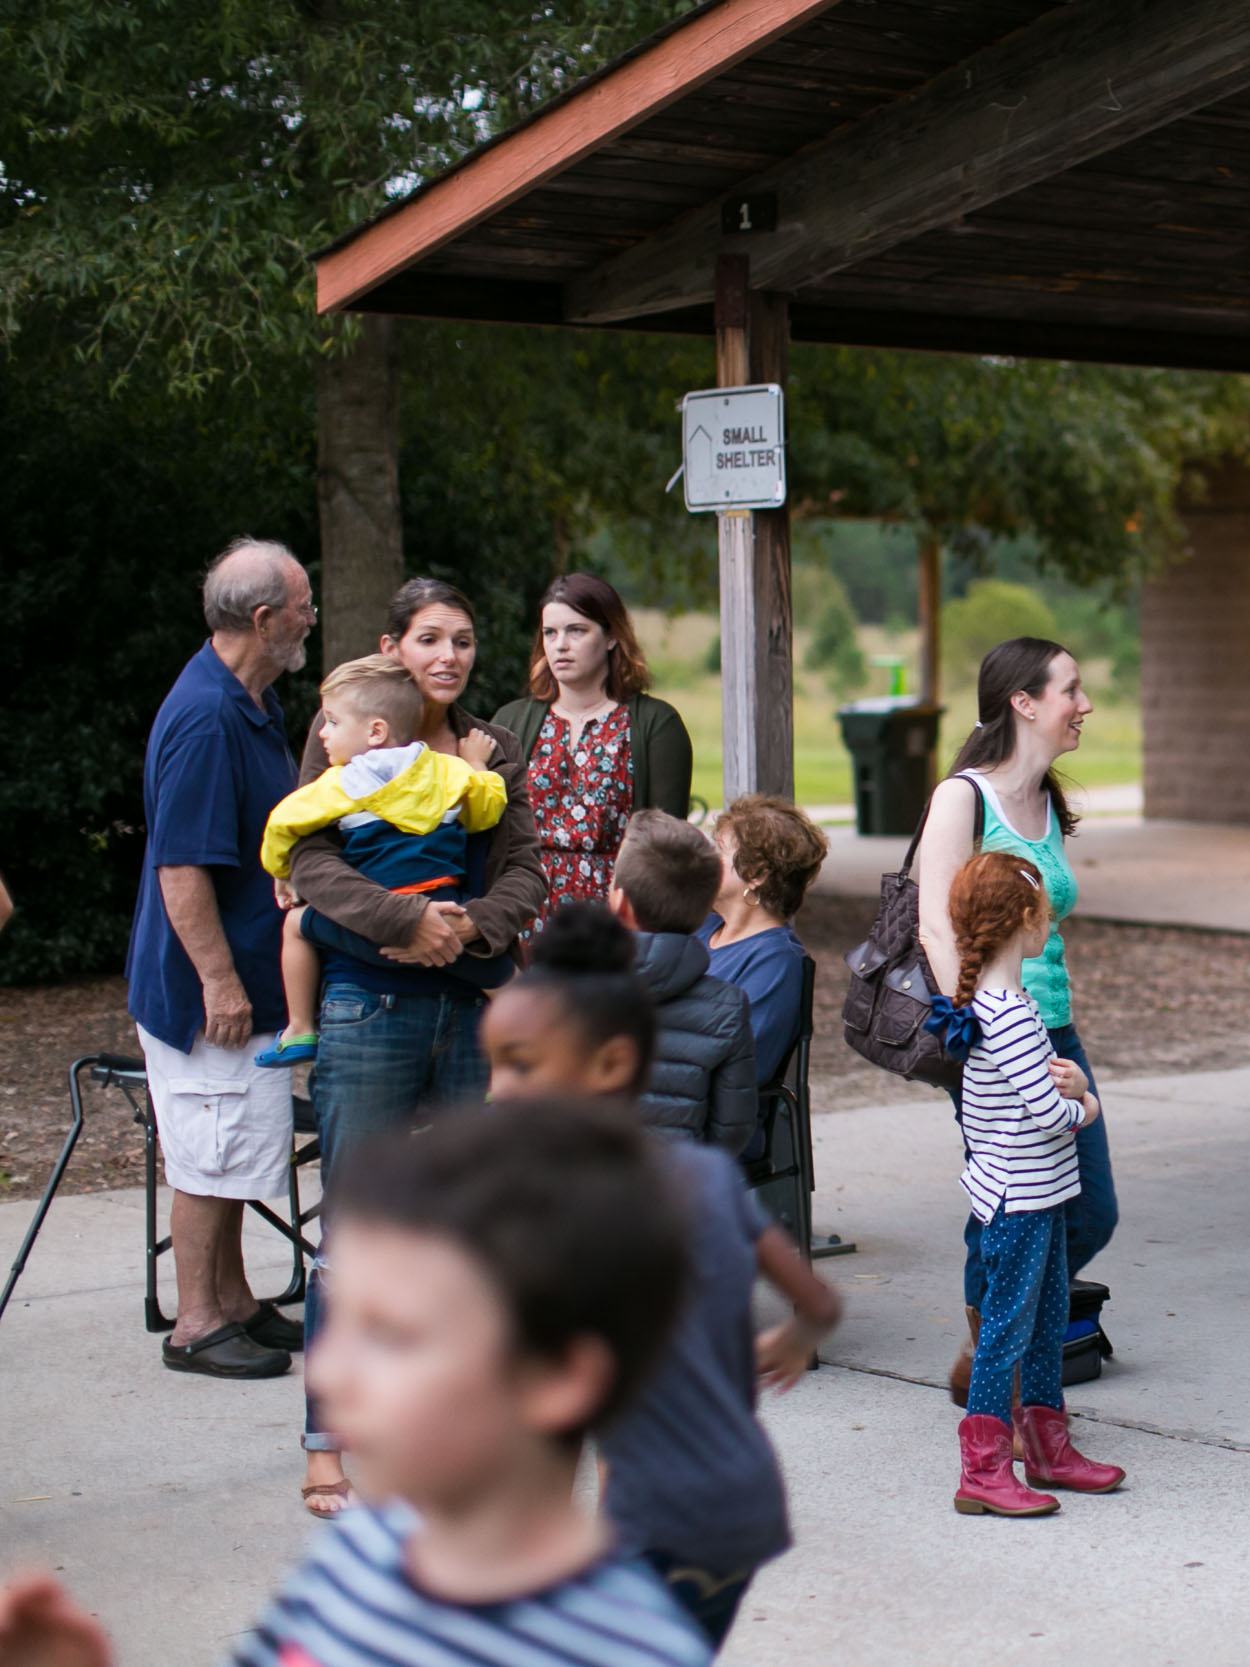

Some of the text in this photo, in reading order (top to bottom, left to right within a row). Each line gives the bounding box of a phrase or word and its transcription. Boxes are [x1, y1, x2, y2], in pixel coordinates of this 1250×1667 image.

[739, 203, 752, 230] 1
[722, 425, 768, 446] SMALL
[715, 450, 776, 470] SHELTER
